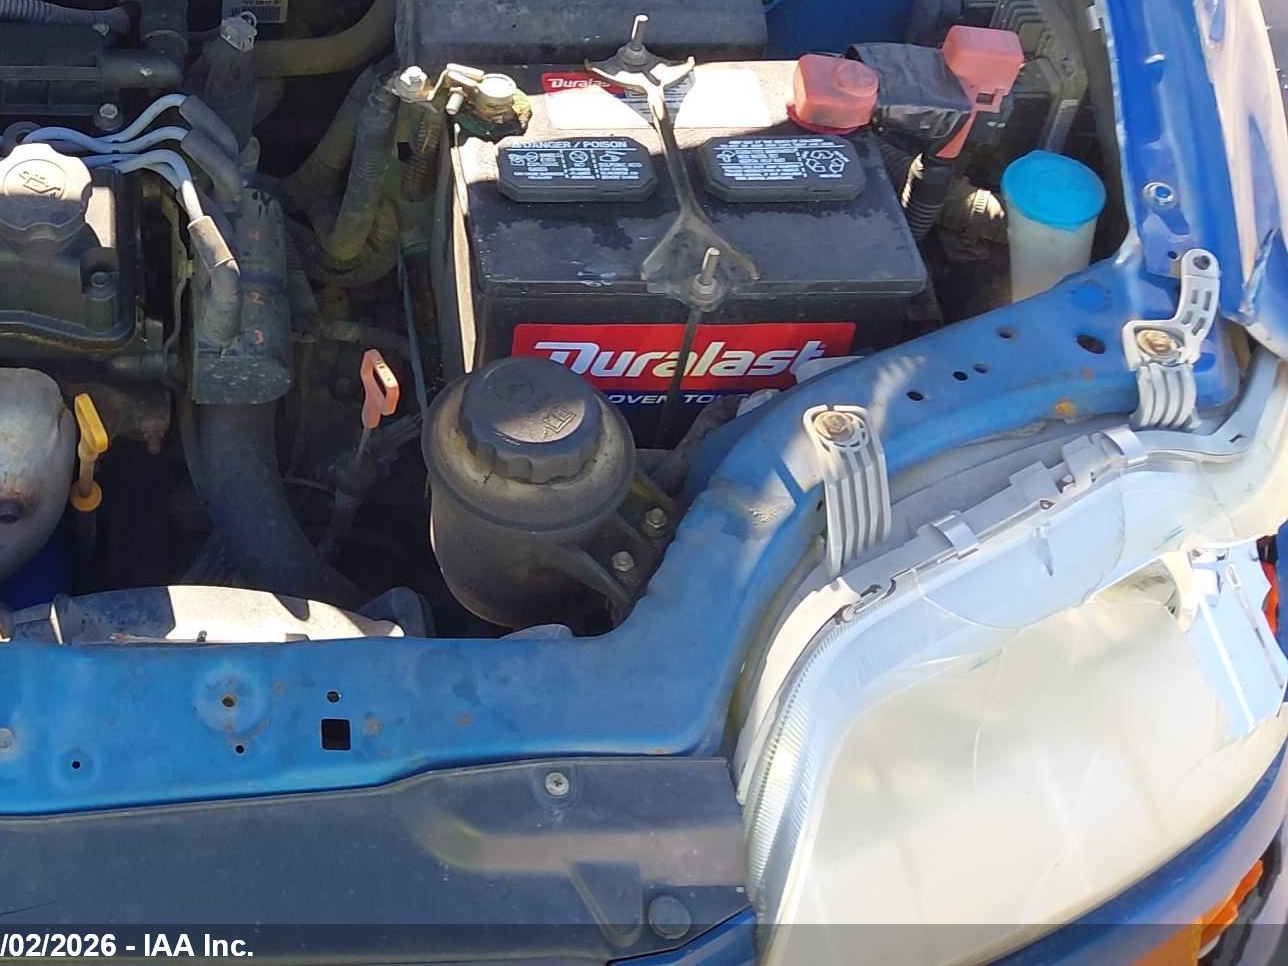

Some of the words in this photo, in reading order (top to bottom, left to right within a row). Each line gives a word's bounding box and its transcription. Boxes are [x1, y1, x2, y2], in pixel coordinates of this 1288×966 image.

[547, 77, 611, 89] Duralas
[520, 140, 572, 149] DANGER
[582, 140, 628, 149] POISON
[253, 329, 265, 346] 3
[534, 340, 826, 379] Duralast
